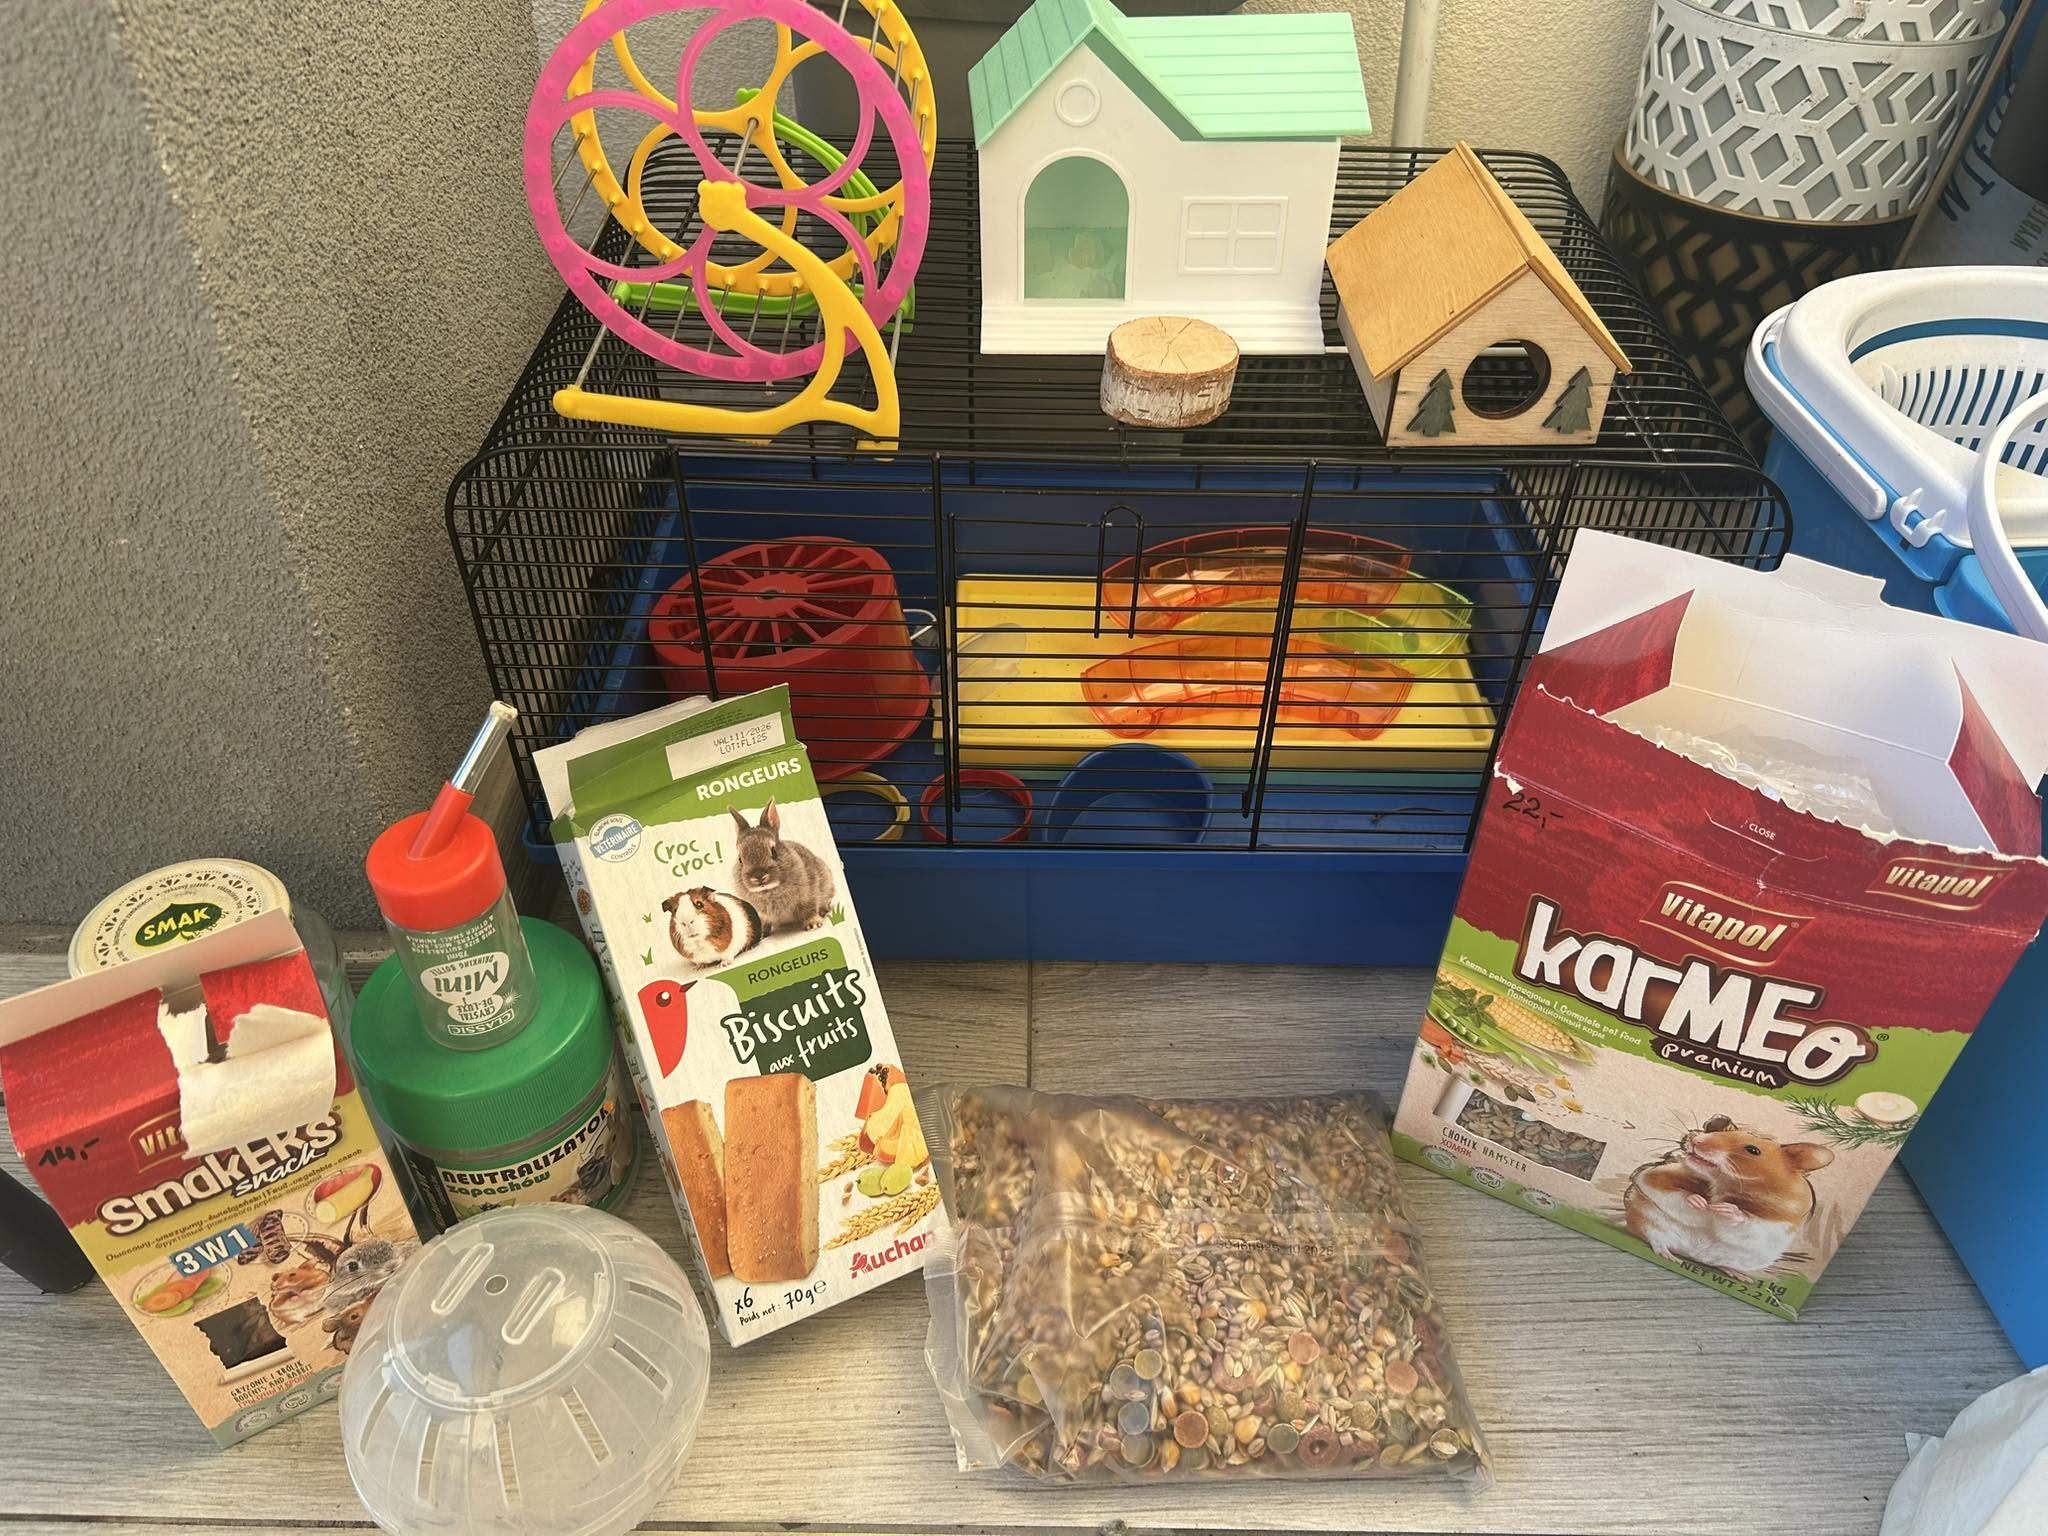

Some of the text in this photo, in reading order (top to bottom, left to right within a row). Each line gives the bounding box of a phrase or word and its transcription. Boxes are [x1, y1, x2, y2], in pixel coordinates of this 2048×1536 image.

[695, 757, 802, 801] RONGEURS
[1749, 822, 1777, 841] CLOSE
[654, 840, 700, 864] Croc
[1884, 866, 1993, 899] Vitapol
[143, 907, 211, 940] SMAK
[1660, 892, 1787, 952] Vitapol
[430, 955, 495, 977] DRINKING BOTTLE
[434, 961, 498, 996] Mini
[748, 949, 829, 984] RONGEURS
[456, 997, 494, 1012] DE-LUXE
[459, 1005, 495, 1021] CRYSTAL
[724, 972, 864, 1061] Biscuits
[1459, 955, 1488, 976] Karma
[1560, 1005, 1601, 1029] Complete
[1602, 1024, 1618, 1038] pet
[1619, 1030, 1642, 1046] food
[450, 1013, 513, 1035] CLASSIC
[1582, 1023, 1606, 1040] корм
[769, 1017, 858, 1073] aux fruits
[1440, 1138, 1472, 1158] ХОМЯК
[1442, 1127, 1477, 1150] CHOMIK
[1482, 1147, 1527, 1173] HAMSTER
[447, 1171, 550, 1198] zapachów
[849, 1230, 935, 1279] Auchan
[1680, 1261, 1710, 1278] NET
[1712, 1275, 1736, 1288] WT
[1738, 1285, 1763, 1300] 2.2
[1768, 1282, 1788, 1296] kg
[735, 1287, 754, 1314] x6
[739, 1309, 761, 1326] Poids
[230, 1376, 268, 1397] GRYZONIE
[277, 1360, 304, 1376] KRÓLIK
[233, 1384, 267, 1403] RODENTS
[269, 1377, 285, 1388] AND
[287, 1363, 314, 1377] RABBIT
